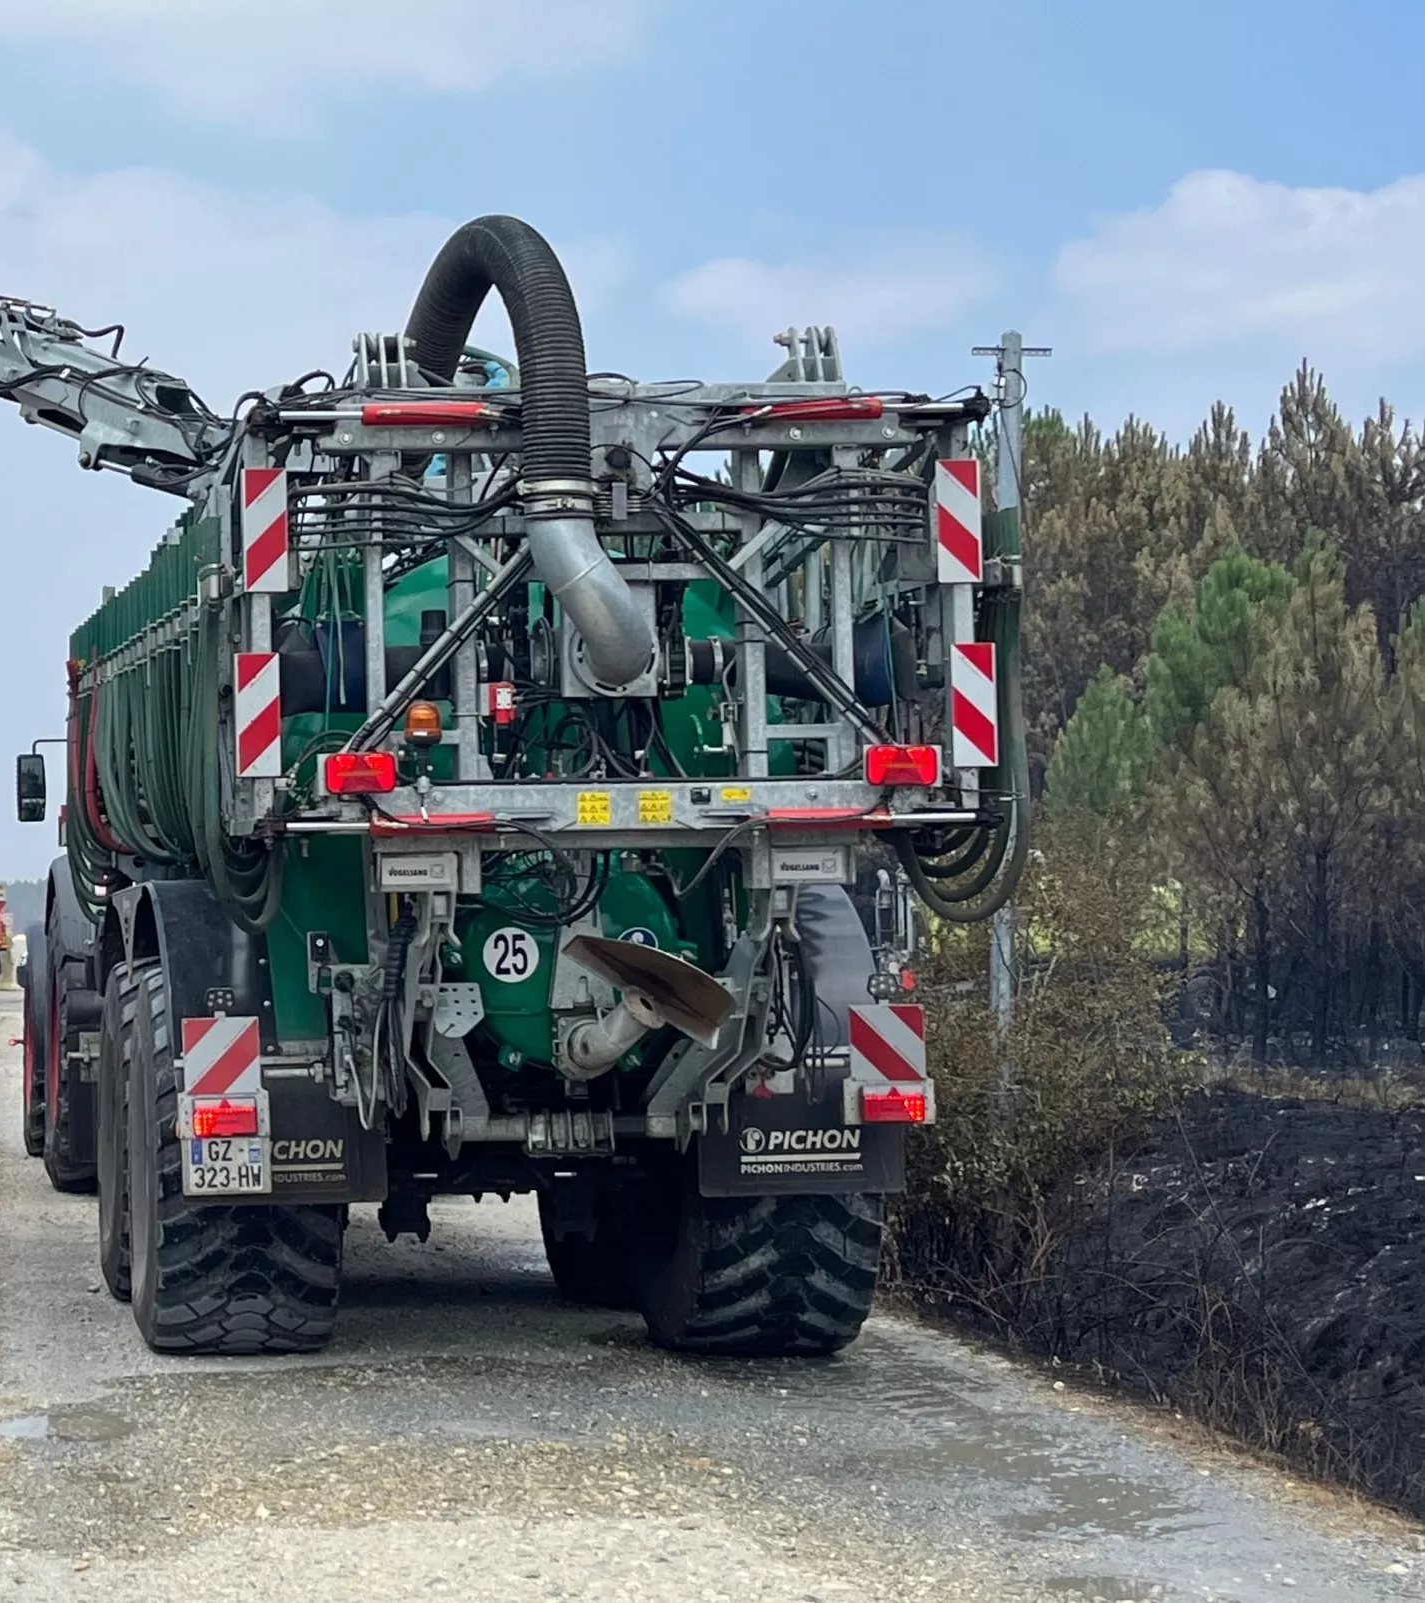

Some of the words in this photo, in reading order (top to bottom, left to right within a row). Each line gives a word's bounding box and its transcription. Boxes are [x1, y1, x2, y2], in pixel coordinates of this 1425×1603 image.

[493, 934, 528, 976] 25
[768, 1129, 861, 1150] PICHON
[194, 1165, 262, 1189] 323-HW
